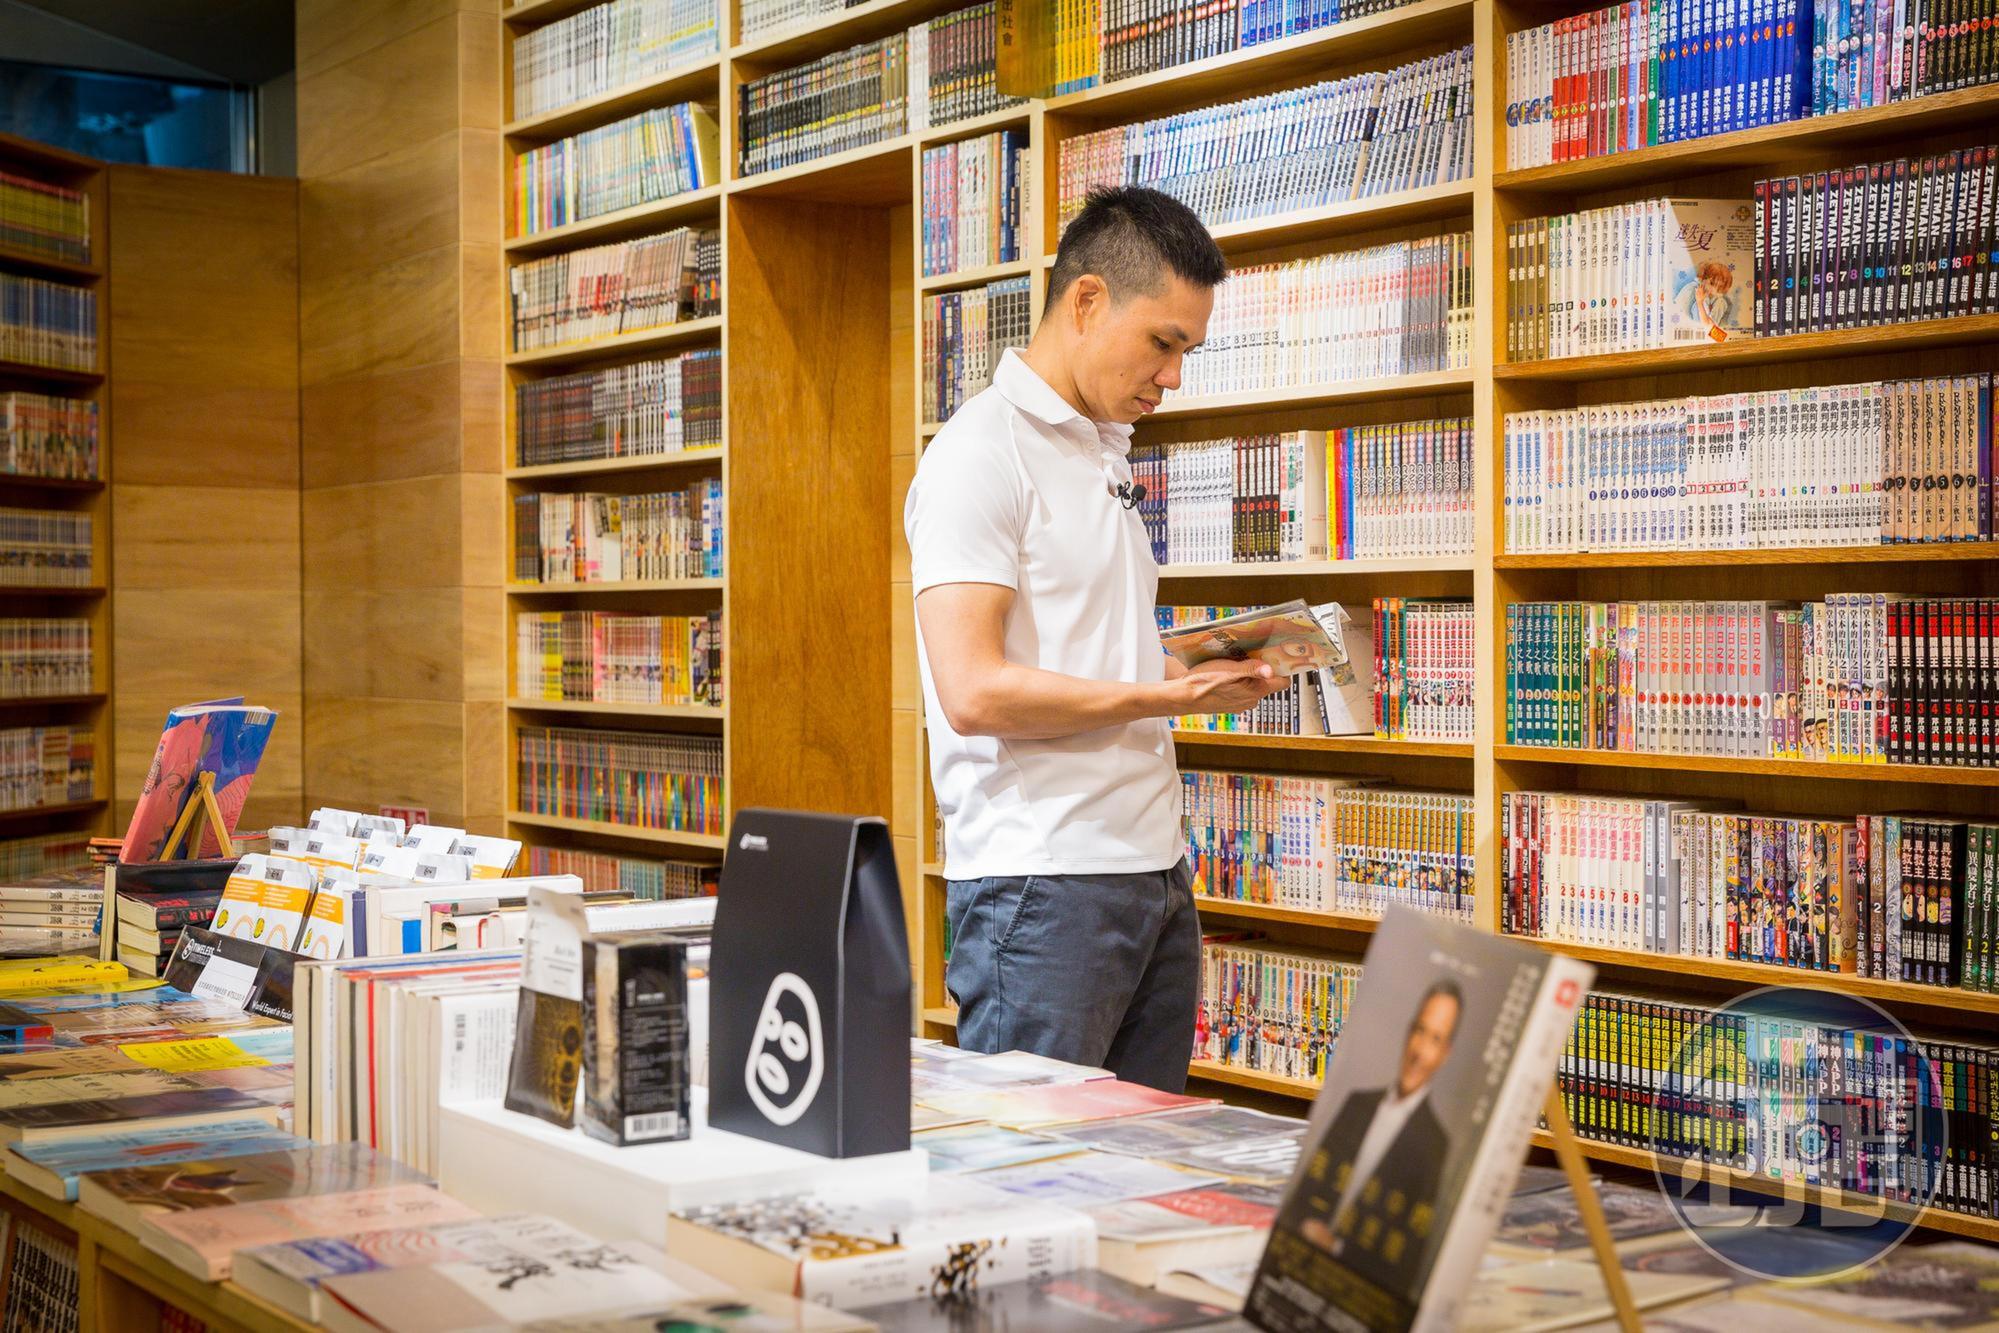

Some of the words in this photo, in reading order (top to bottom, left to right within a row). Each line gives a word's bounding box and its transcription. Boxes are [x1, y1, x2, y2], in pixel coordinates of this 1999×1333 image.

[1956, 171, 1969, 231] ZETMAN
[1967, 169, 1980, 230] ZETMAN
[1981, 166, 1994, 227] ZETMAN
[1918, 177, 1931, 237] ZETMAN
[1931, 176, 1944, 235] ZETMAN
[1943, 173, 1955, 232] ZETMAN
[1867, 184, 1878, 242] ZETMAN
[1878, 183, 1890, 242] ZETMAN
[1891, 182, 1903, 240] ZETMAN
[1905, 181, 1917, 239] ZETMAN
[1828, 190, 1838, 248] ZETMAN
[1841, 189, 1852, 246] ZETMAN
[1852, 187, 1863, 245] ZETMAN
[1785, 197, 1795, 255] ZETMAN
[1802, 195, 1812, 253] ZETMAN
[1815, 192, 1824, 251] ZETMAN
[1756, 201, 1764, 258] ZETMAN
[1771, 199, 1780, 257] ZETMAN
[1928, 261, 1937, 271] 14
[1938, 259, 1948, 269] 15
[1952, 257, 1961, 268] 16
[1864, 267, 1871, 277] 9
[1876, 267, 1885, 277] 10
[1888, 266, 1897, 276] 11
[1901, 265, 1911, 275] 12
[1813, 275, 1821, 285] 5
[1826, 272, 1833, 282] 6
[1840, 271, 1847, 281] 7
[1756, 281, 1762, 291] 1
[1771, 278, 1778, 289] 2
[1786, 278, 1793, 288] 3
[1624, 295, 1627, 305] 1
[1634, 295, 1639, 305] 2
[1647, 295, 1651, 304] 3
[1801, 486, 1807, 494] 6
[1810, 486, 1815, 494] 7
[1831, 485, 1837, 493] 9
[1851, 484, 1859, 492] 11
[1873, 482, 1881, 491] 13
[1750, 490, 1753, 498] 1
[1759, 489, 1764, 497] 2
[1781, 488, 1786, 496] 4
[1904, 704, 1910, 713] 2
[1918, 704, 1924, 713] 3
[1931, 704, 1938, 714] 4
[1945, 704, 1951, 714] 5
[1956, 705, 1962, 714] 6
[1982, 706, 1988, 715] 8
[1561, 886, 1566, 896] 2
[1570, 887, 1575, 897] 3
[1580, 889, 1585, 898] 4
[1590, 889, 1595, 899] 5
[1600, 890, 1605, 900] 6
[1610, 892, 1615, 902] 7
[1623, 893, 1628, 903] 8
[1633, 894, 1639, 905] 9
[1858, 901, 1862, 911] 1
[1874, 902, 1880, 913] 2
[194, 943, 215, 955] TIMELESS
[1967, 939, 1972, 950] 1
[1982, 943, 1988, 953] 2
[1590, 1084, 1594, 1093] 9
[1601, 1086, 1607, 1095] 10
[1611, 1088, 1616, 1097] 11
[1622, 1090, 1629, 1099] 12
